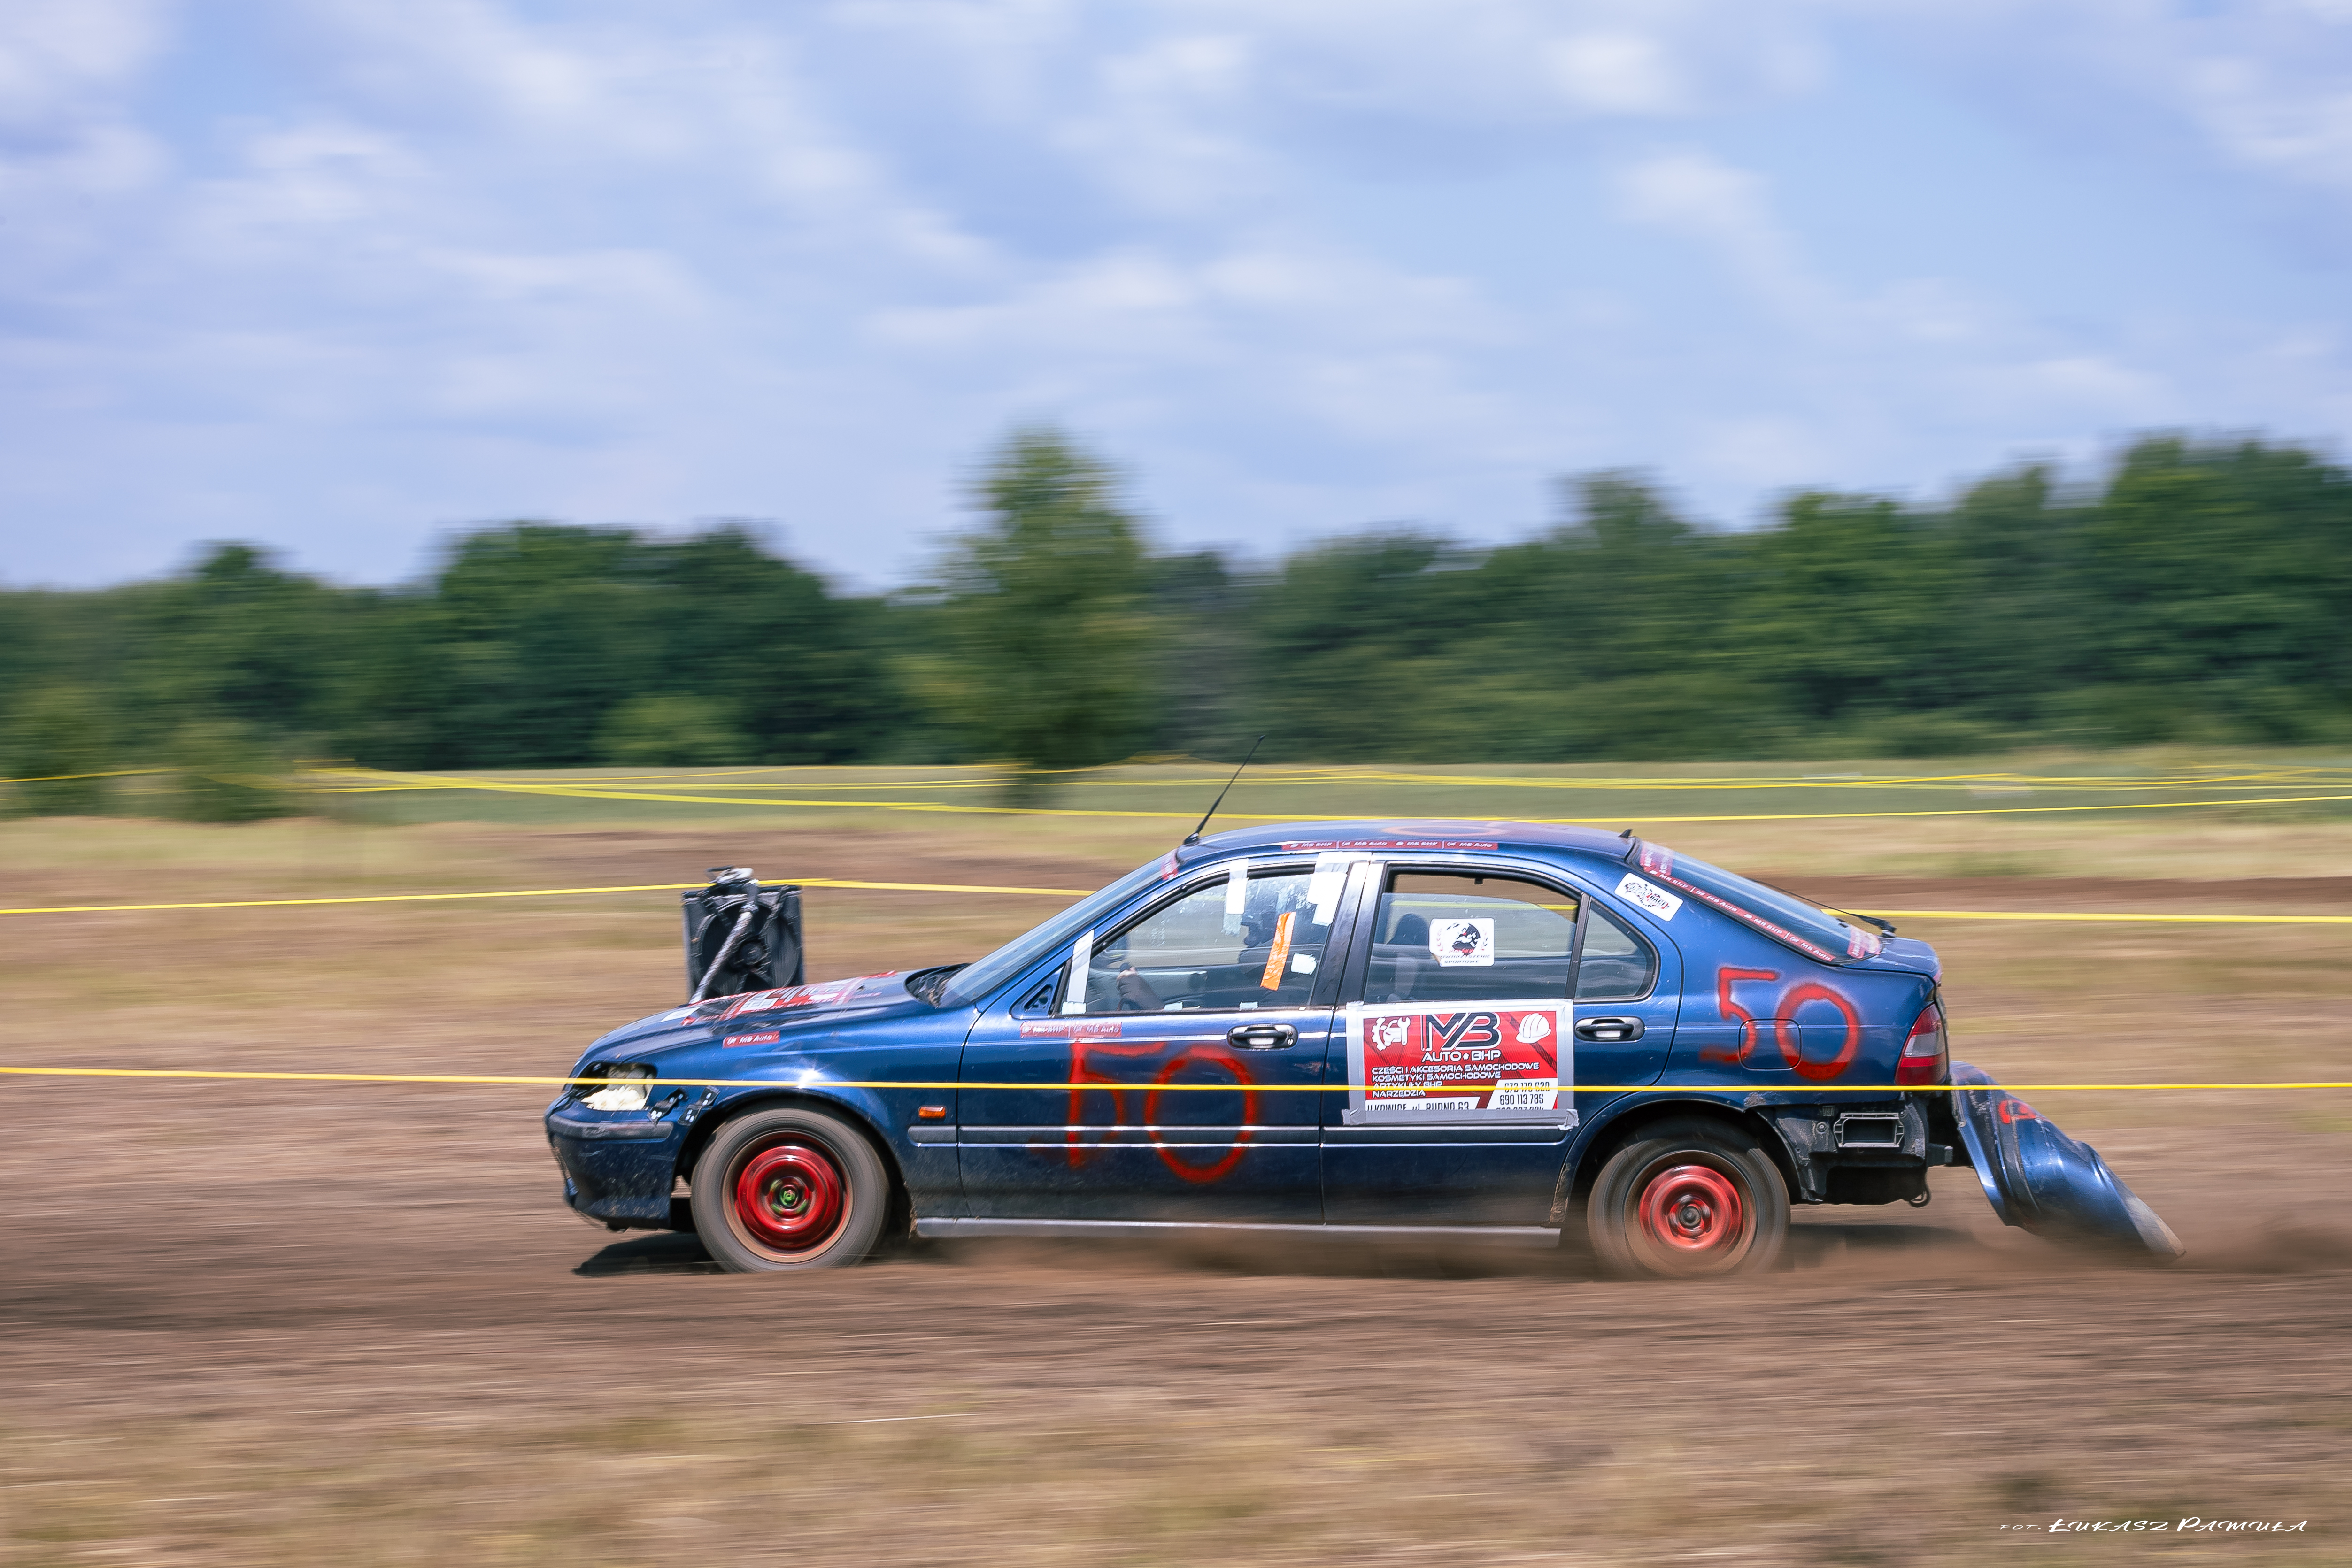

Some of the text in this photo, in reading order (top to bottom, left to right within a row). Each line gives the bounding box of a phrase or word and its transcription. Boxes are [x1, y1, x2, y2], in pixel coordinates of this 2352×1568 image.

[1699, 967, 1860, 1080] 50
[1422, 1050, 1502, 1063] AUTO BHP
[1372, 1066, 1404, 1075] CZĘŚCI
[1410, 1064, 1463, 1074] AKCESORIA
[1465, 1062, 1540, 1072] SAMOCHODOWE
[1372, 1071, 1501, 1083] KOSMETYKI SAMOCHODOWE
[1372, 1089, 1427, 1099] NARZĘDZIA
[1500, 1093, 1543, 1105] 690 113 785
